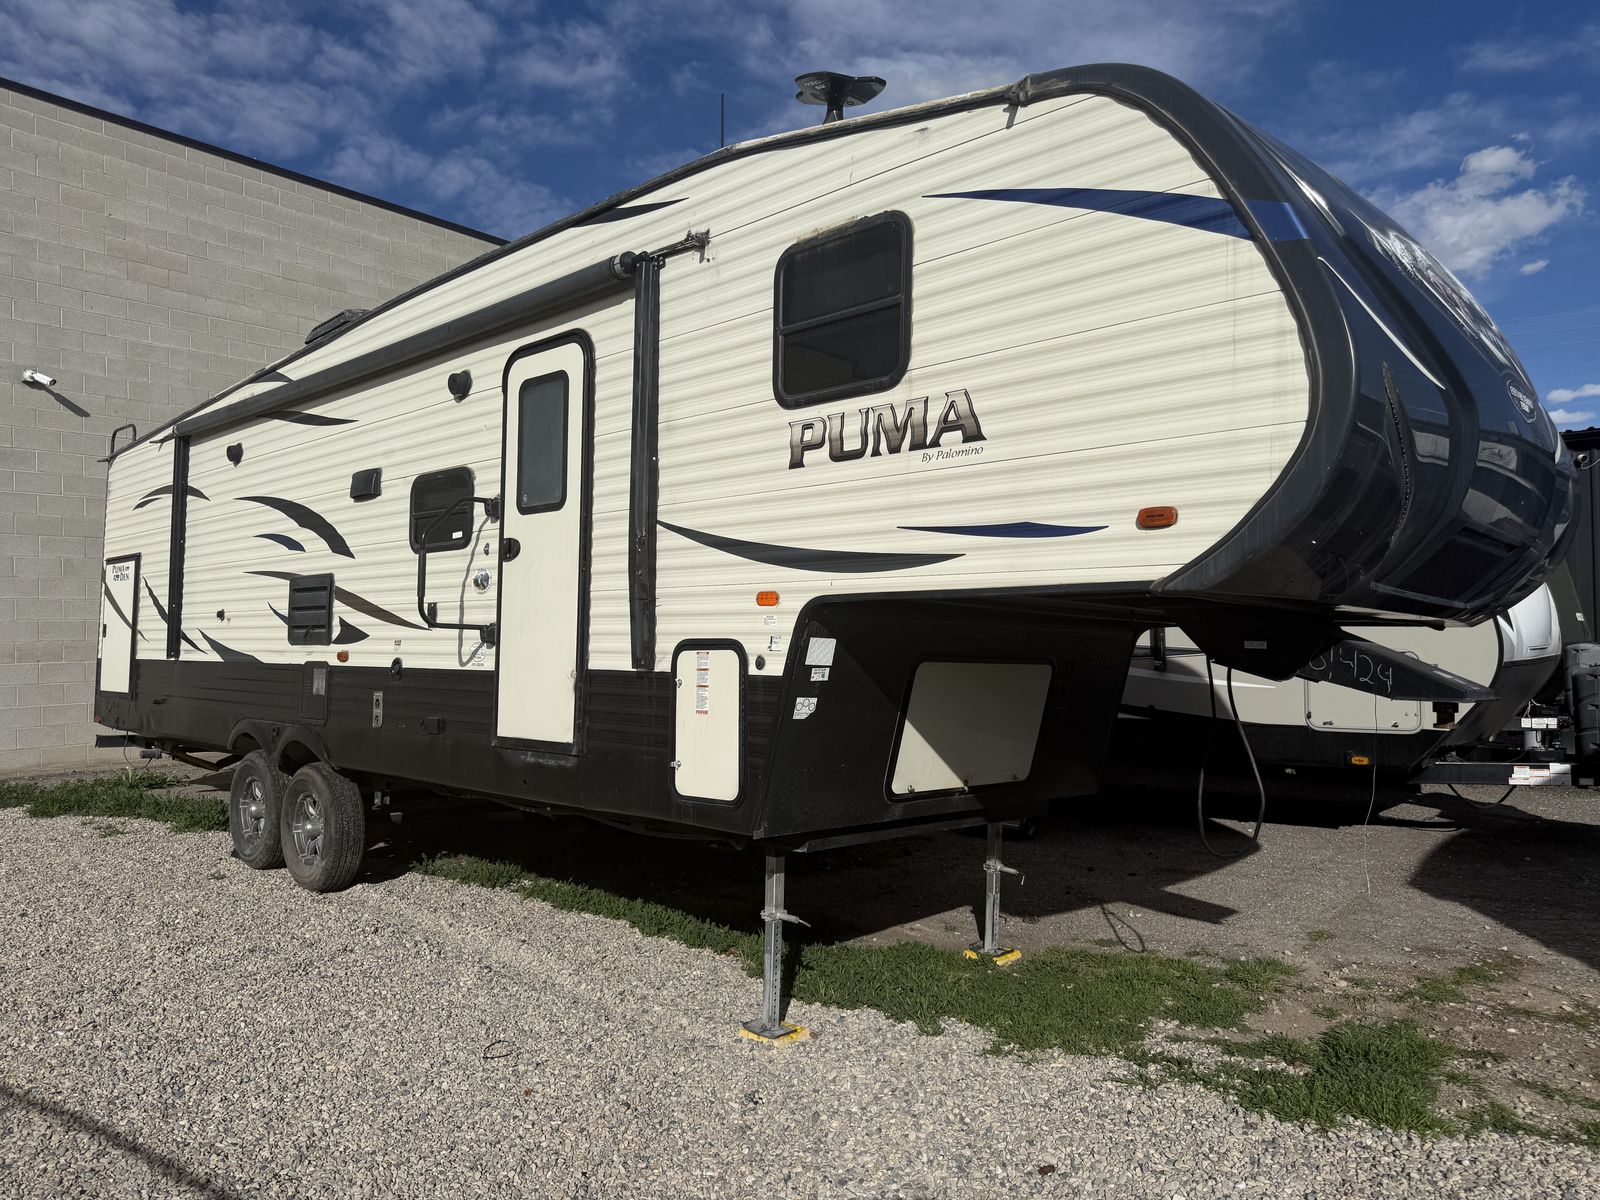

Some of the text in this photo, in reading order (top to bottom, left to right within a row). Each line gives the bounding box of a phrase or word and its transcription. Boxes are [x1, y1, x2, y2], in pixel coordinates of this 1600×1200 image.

[788, 388, 988, 470] PUMA
[921, 446, 984, 463] By Palomino
